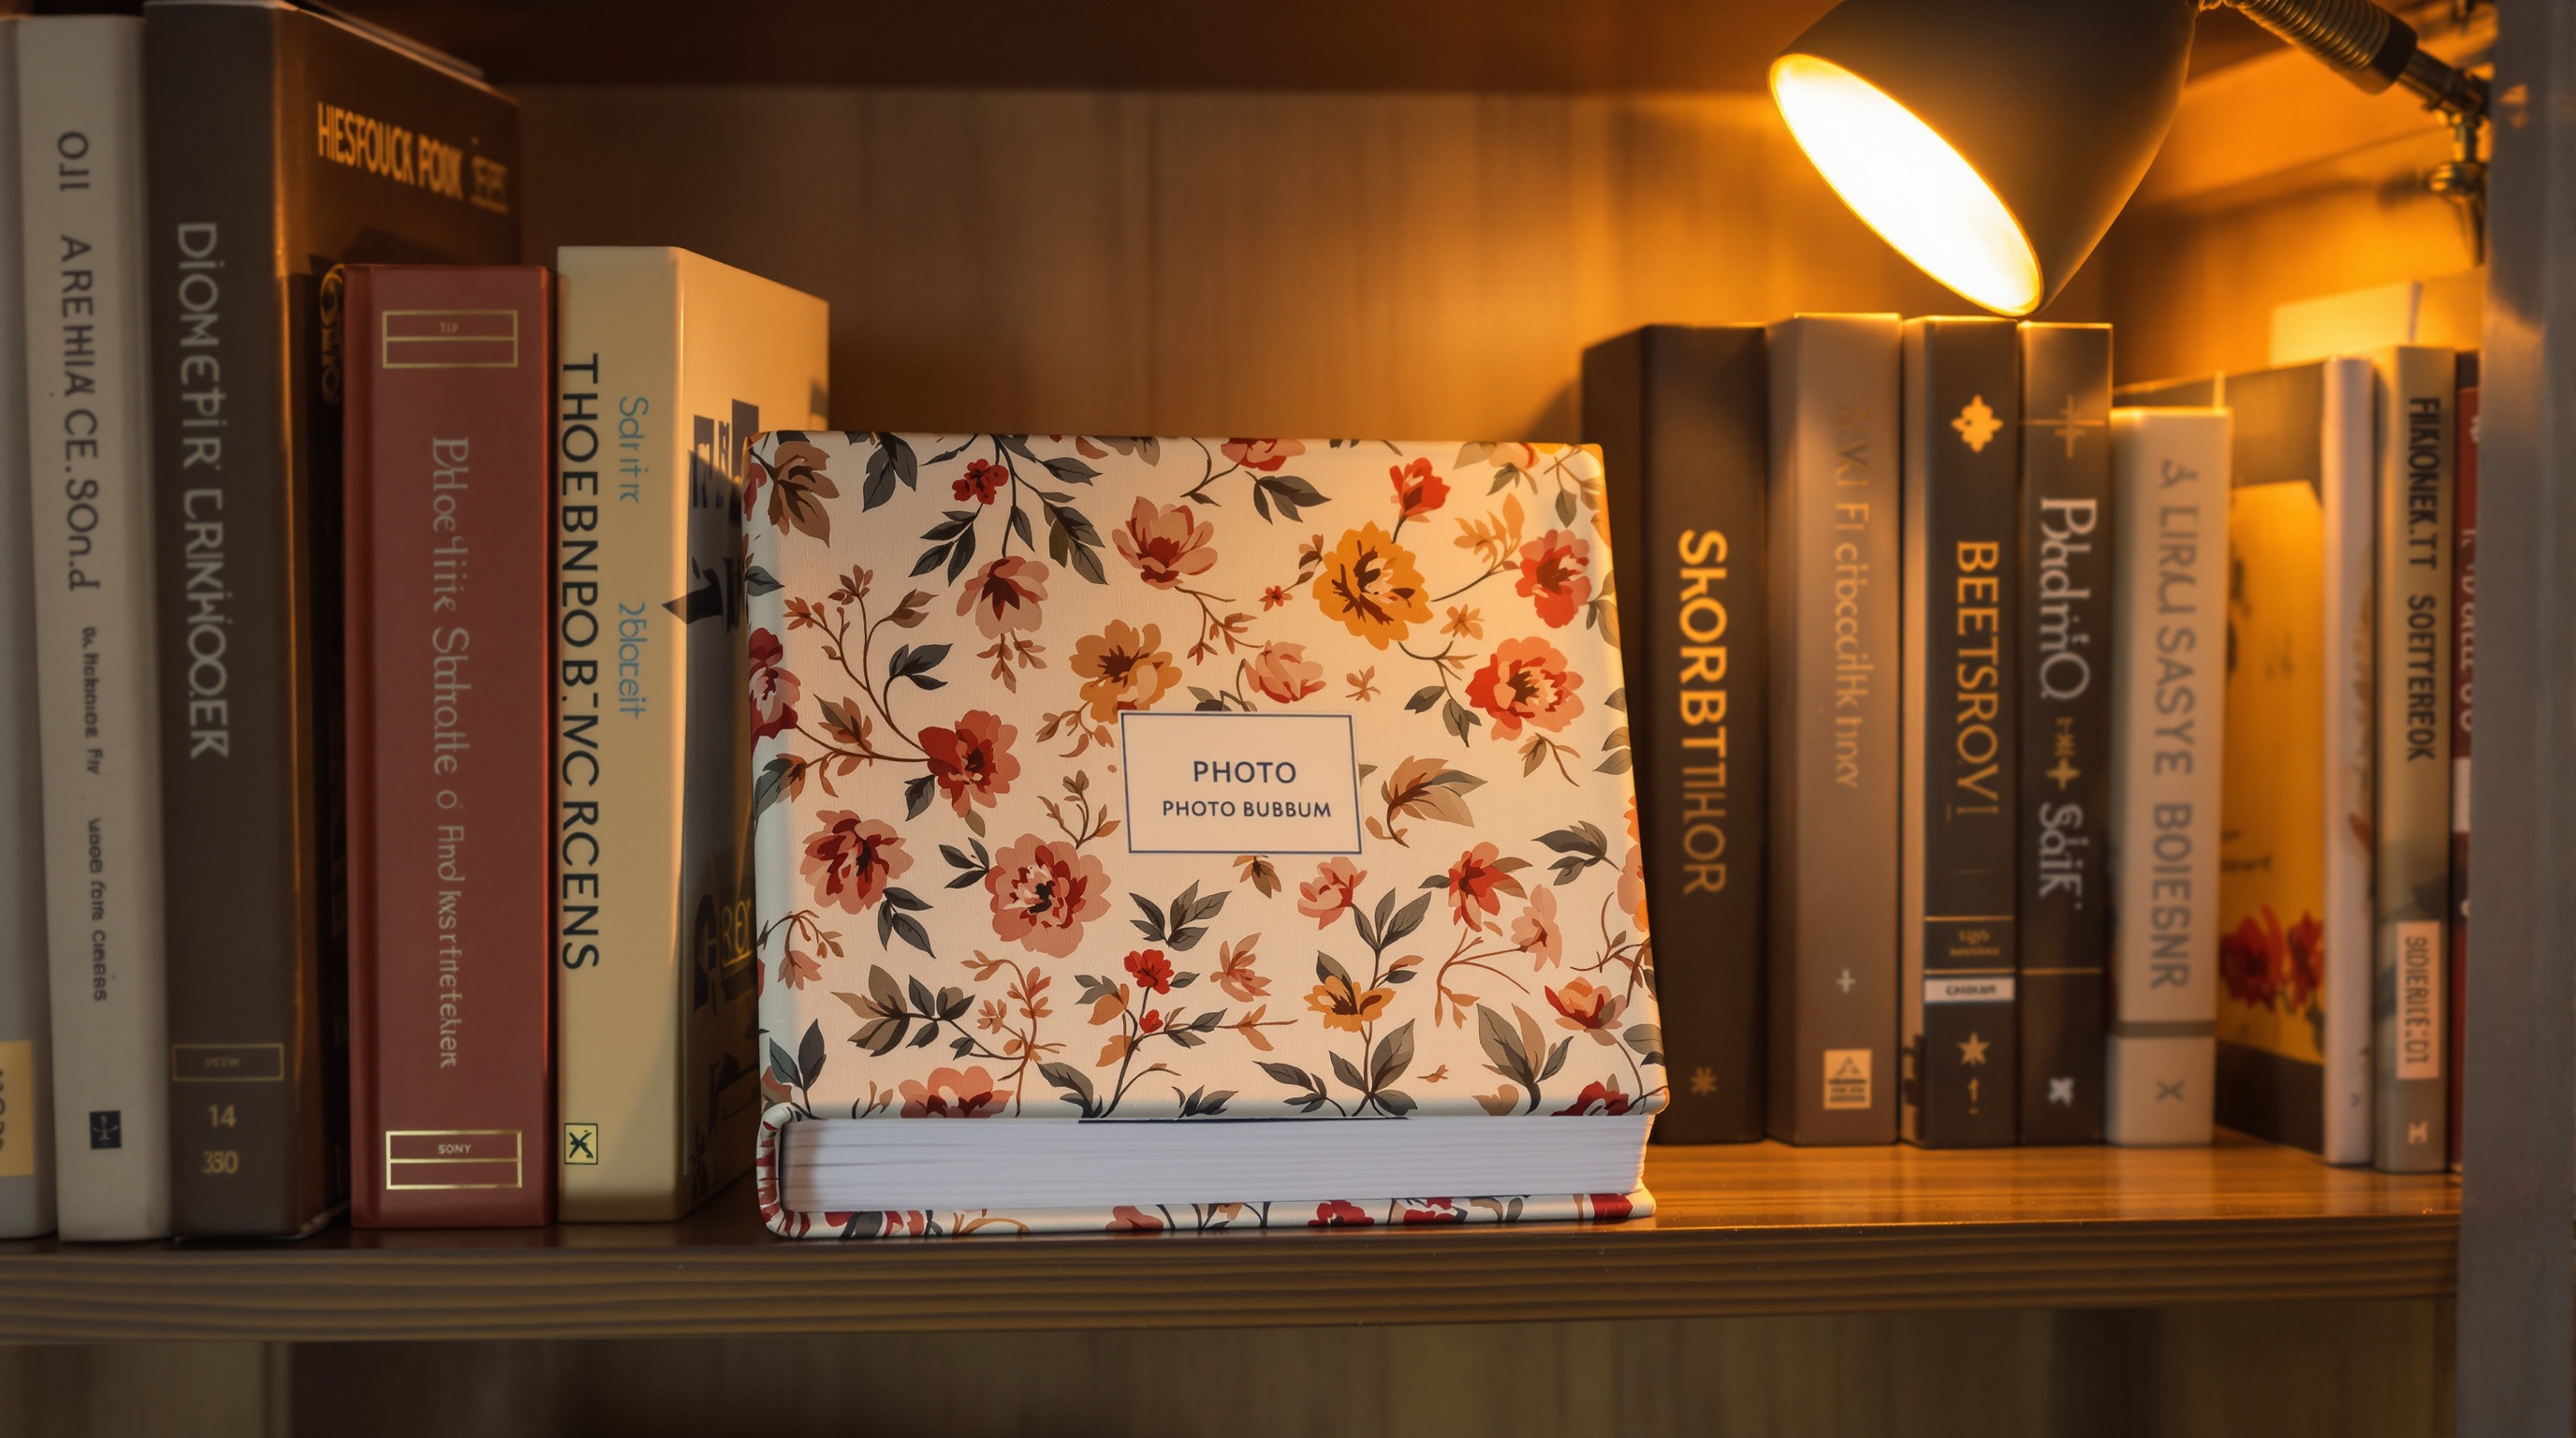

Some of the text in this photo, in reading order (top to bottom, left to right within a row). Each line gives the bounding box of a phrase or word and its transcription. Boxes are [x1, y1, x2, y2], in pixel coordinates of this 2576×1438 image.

[1193, 760, 1296, 784] PHOTO
[1163, 800, 1331, 817] PHOTO BUBBUM
[208, 1104, 237, 1128] 14
[437, 1144, 472, 1154] SONY
